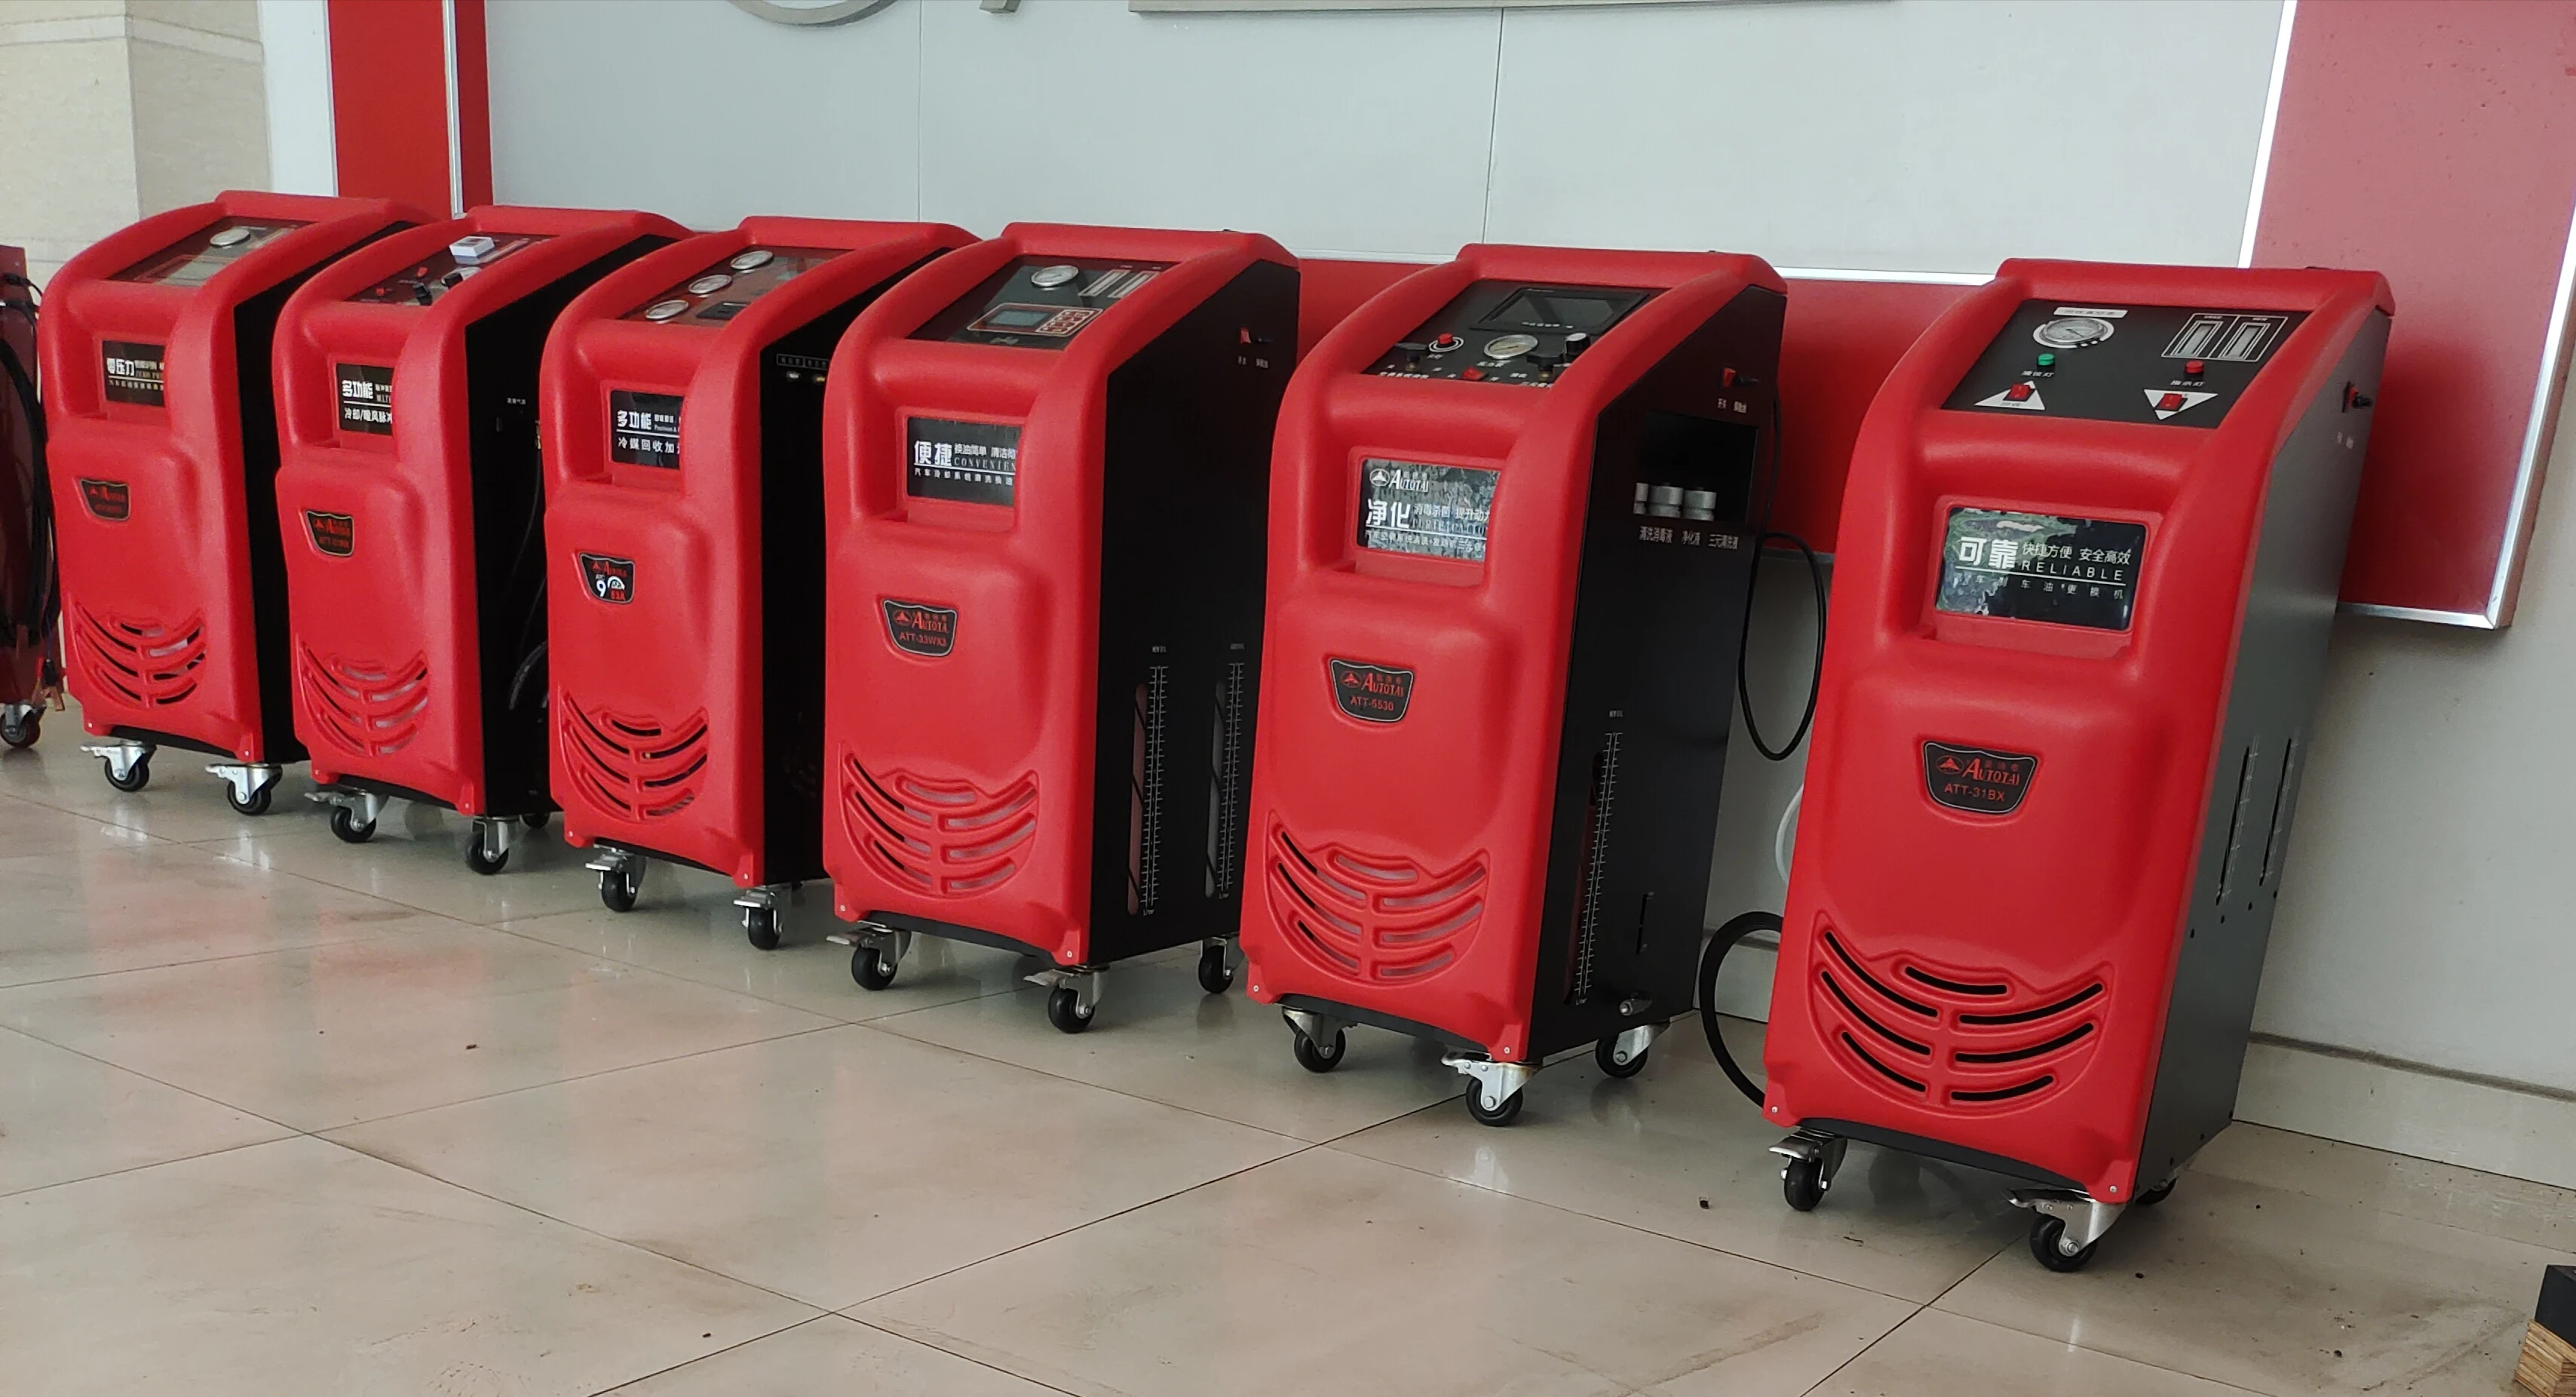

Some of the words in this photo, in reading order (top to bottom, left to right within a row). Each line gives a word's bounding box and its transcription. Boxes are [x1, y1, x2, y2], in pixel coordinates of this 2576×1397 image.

[342, 379, 373, 400] 多功能
[617, 410, 652, 431] 多功能
[913, 440, 952, 467] 便捷
[953, 442, 987, 457] 换油简单
[1388, 469, 1429, 493] AUTOTAI
[1366, 498, 1411, 529] 净化
[1413, 502, 1451, 518] 消毒杀菌
[1959, 536, 2019, 570] 可靠
[2022, 542, 2073, 560] 快捷方便
[2079, 548, 2132, 566] 安全高效
[2021, 560, 2124, 582] RELIABLE
[1360, 672, 1404, 698] AUTOTAI
[1962, 757, 2020, 785] AUTOTAI
[1944, 783, 2004, 801] ATT-31BX
